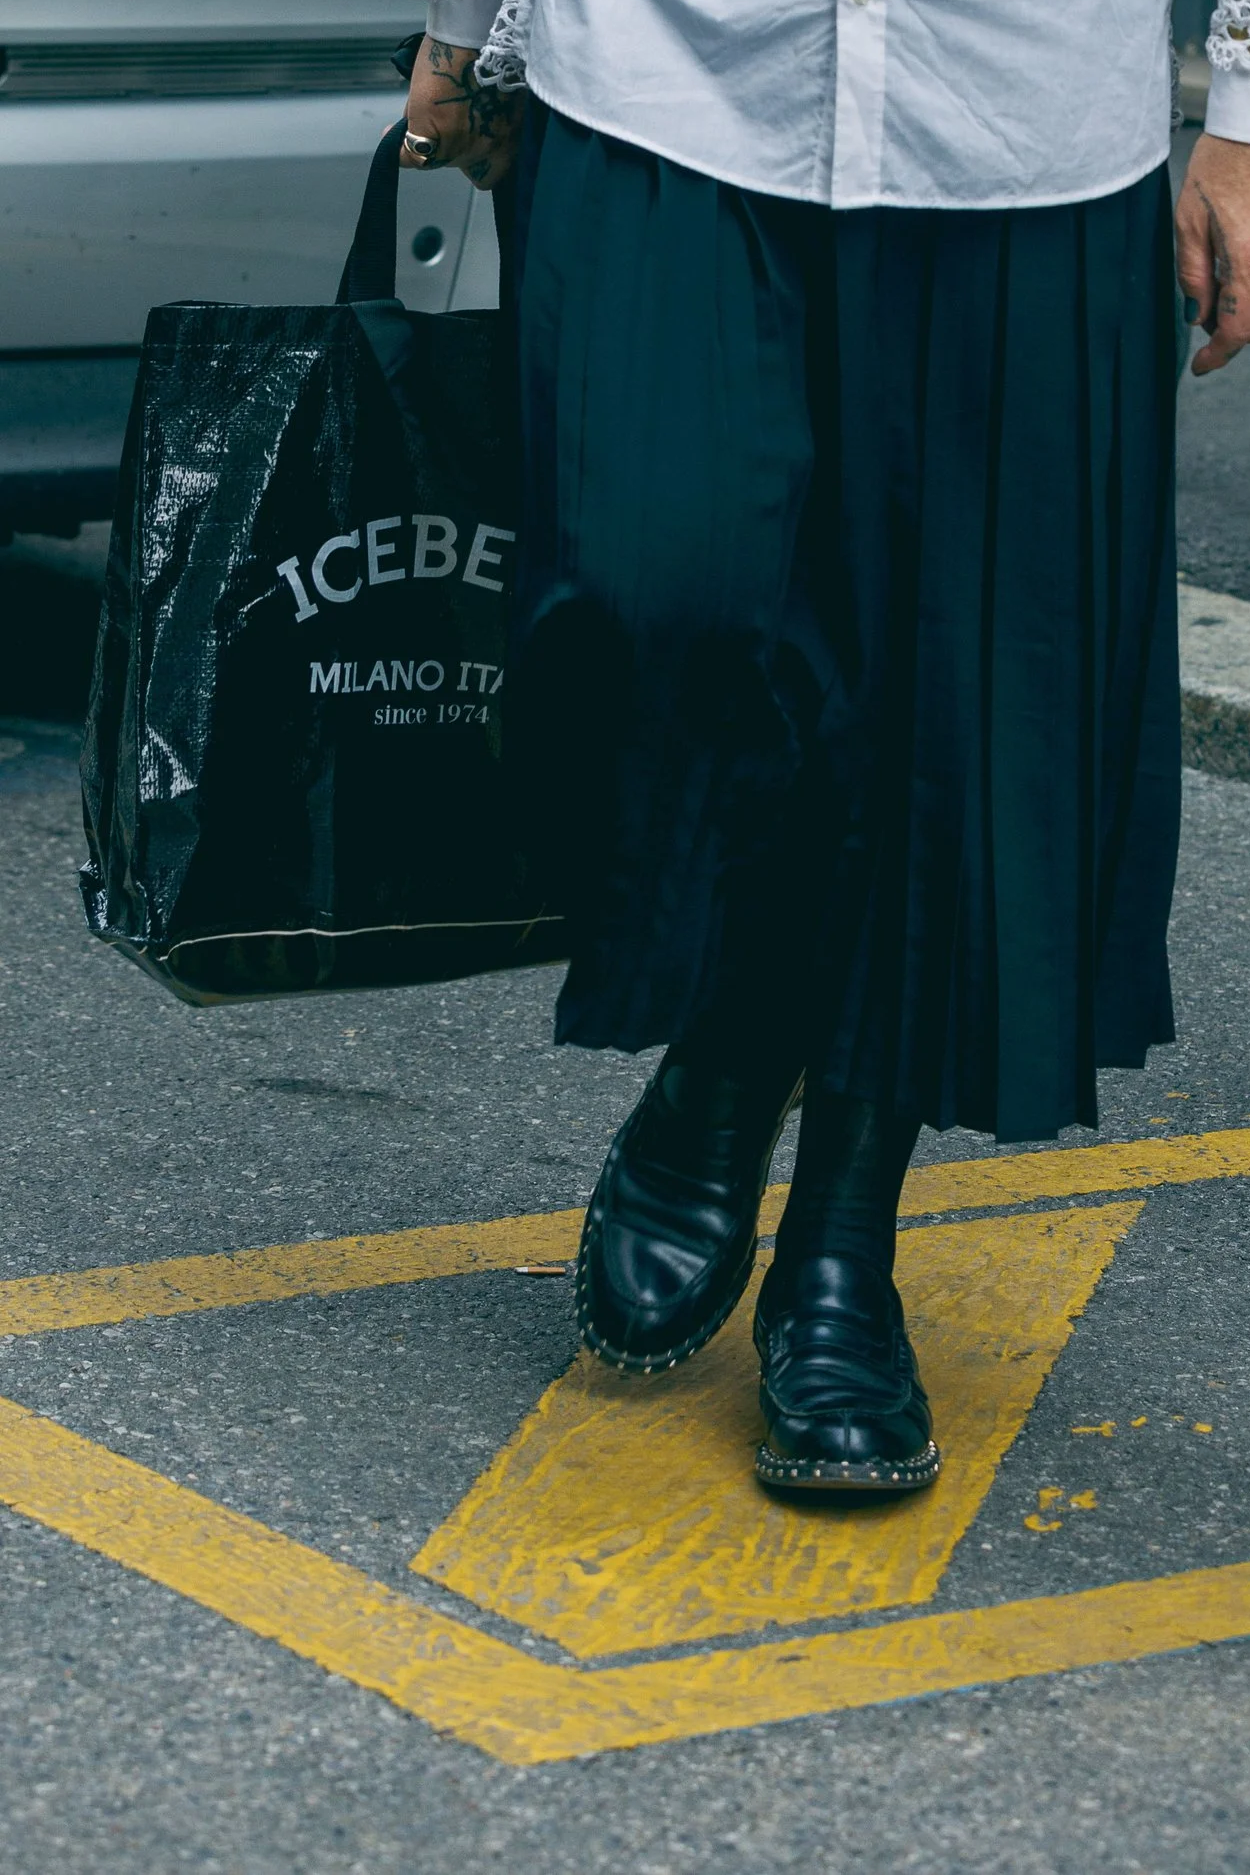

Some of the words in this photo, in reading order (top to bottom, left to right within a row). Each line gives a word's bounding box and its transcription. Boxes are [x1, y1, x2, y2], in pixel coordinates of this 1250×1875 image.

[309, 660, 445, 694] MILANO
[374, 705, 427, 725] since
[436, 703, 490, 725] 1974
